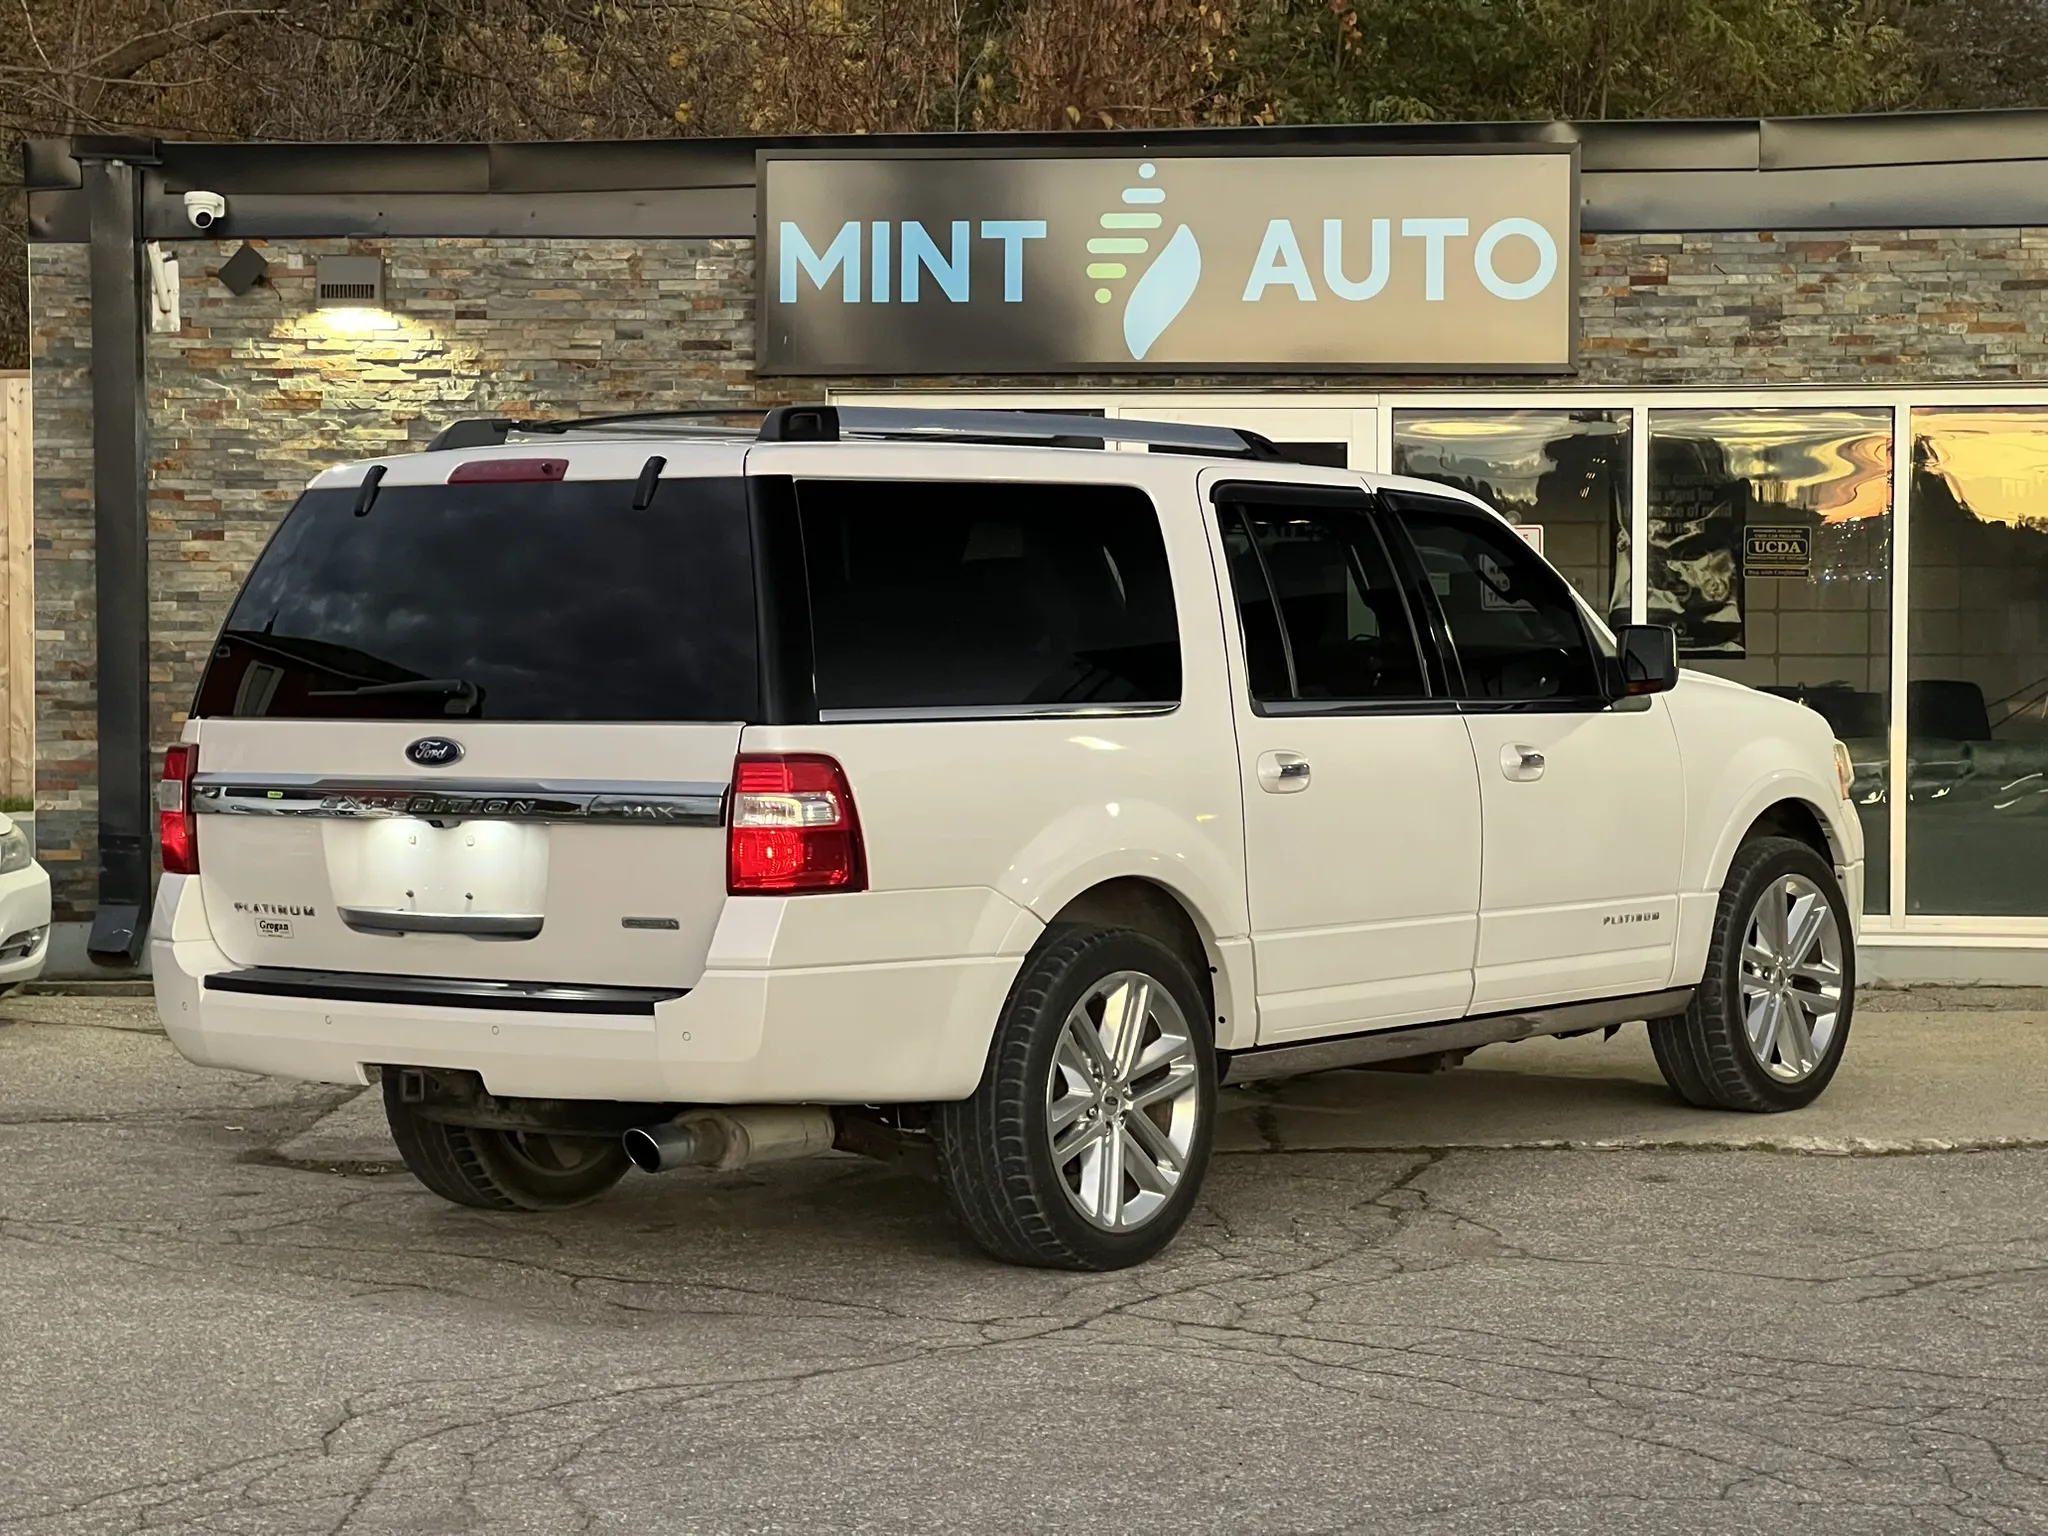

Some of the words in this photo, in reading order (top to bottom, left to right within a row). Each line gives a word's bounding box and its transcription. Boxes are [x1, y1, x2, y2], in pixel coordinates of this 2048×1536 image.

[779, 219, 1047, 304] MINT
[1242, 216, 1559, 303] AUTO
[1754, 541, 1802, 553] UCDA
[414, 740, 449, 759] Ford
[320, 795, 536, 815] EXPEDITION
[623, 805, 675, 819] MAX
[233, 902, 316, 917] PLATINUM
[1603, 911, 1660, 926] PLATINUM
[258, 920, 289, 933] Grogan
